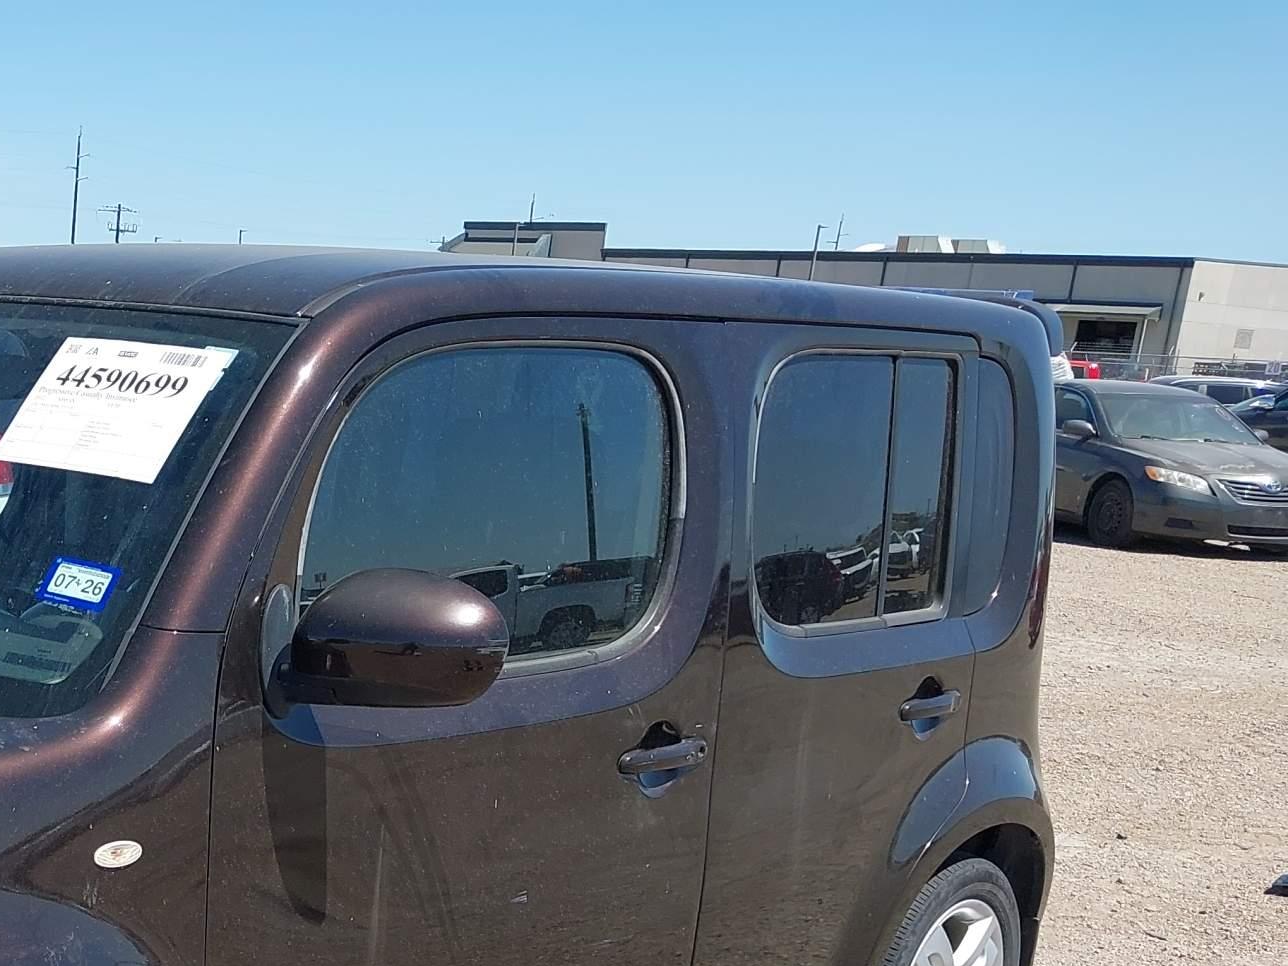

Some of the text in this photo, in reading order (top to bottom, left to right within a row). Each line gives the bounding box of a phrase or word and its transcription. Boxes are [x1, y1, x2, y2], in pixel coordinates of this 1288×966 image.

[56, 364, 189, 399] 44590699
[54, 573, 105, 597] 07 26
